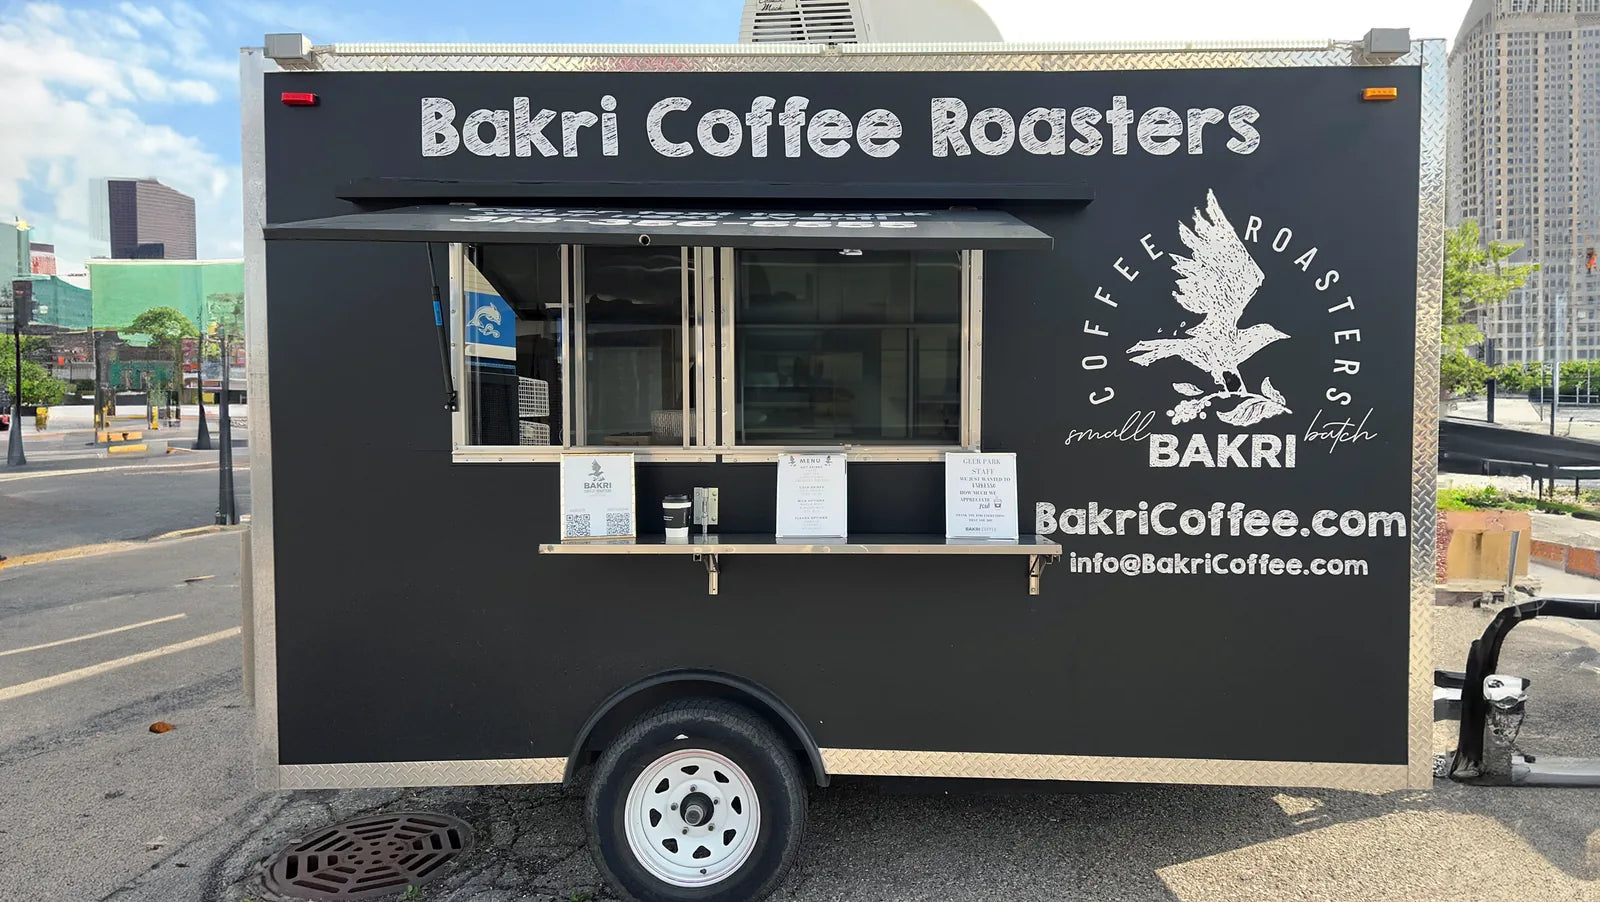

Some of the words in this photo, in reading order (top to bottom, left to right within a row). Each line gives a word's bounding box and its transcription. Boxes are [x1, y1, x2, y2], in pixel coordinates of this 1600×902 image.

[421, 95, 619, 157] Bakri
[646, 95, 903, 158] Coffee
[931, 95, 1261, 157] Roasters
[1081, 233, 1164, 405] COFFEE
[1244, 215, 1361, 406] ROASTERS
[1064, 410, 1156, 445] small
[1303, 407, 1378, 454] batch
[1149, 433, 1296, 468] BAKRI
[1035, 501, 1407, 537] BakriCoffee.com
[1069, 551, 1369, 576] info@BakriCoffee.com
